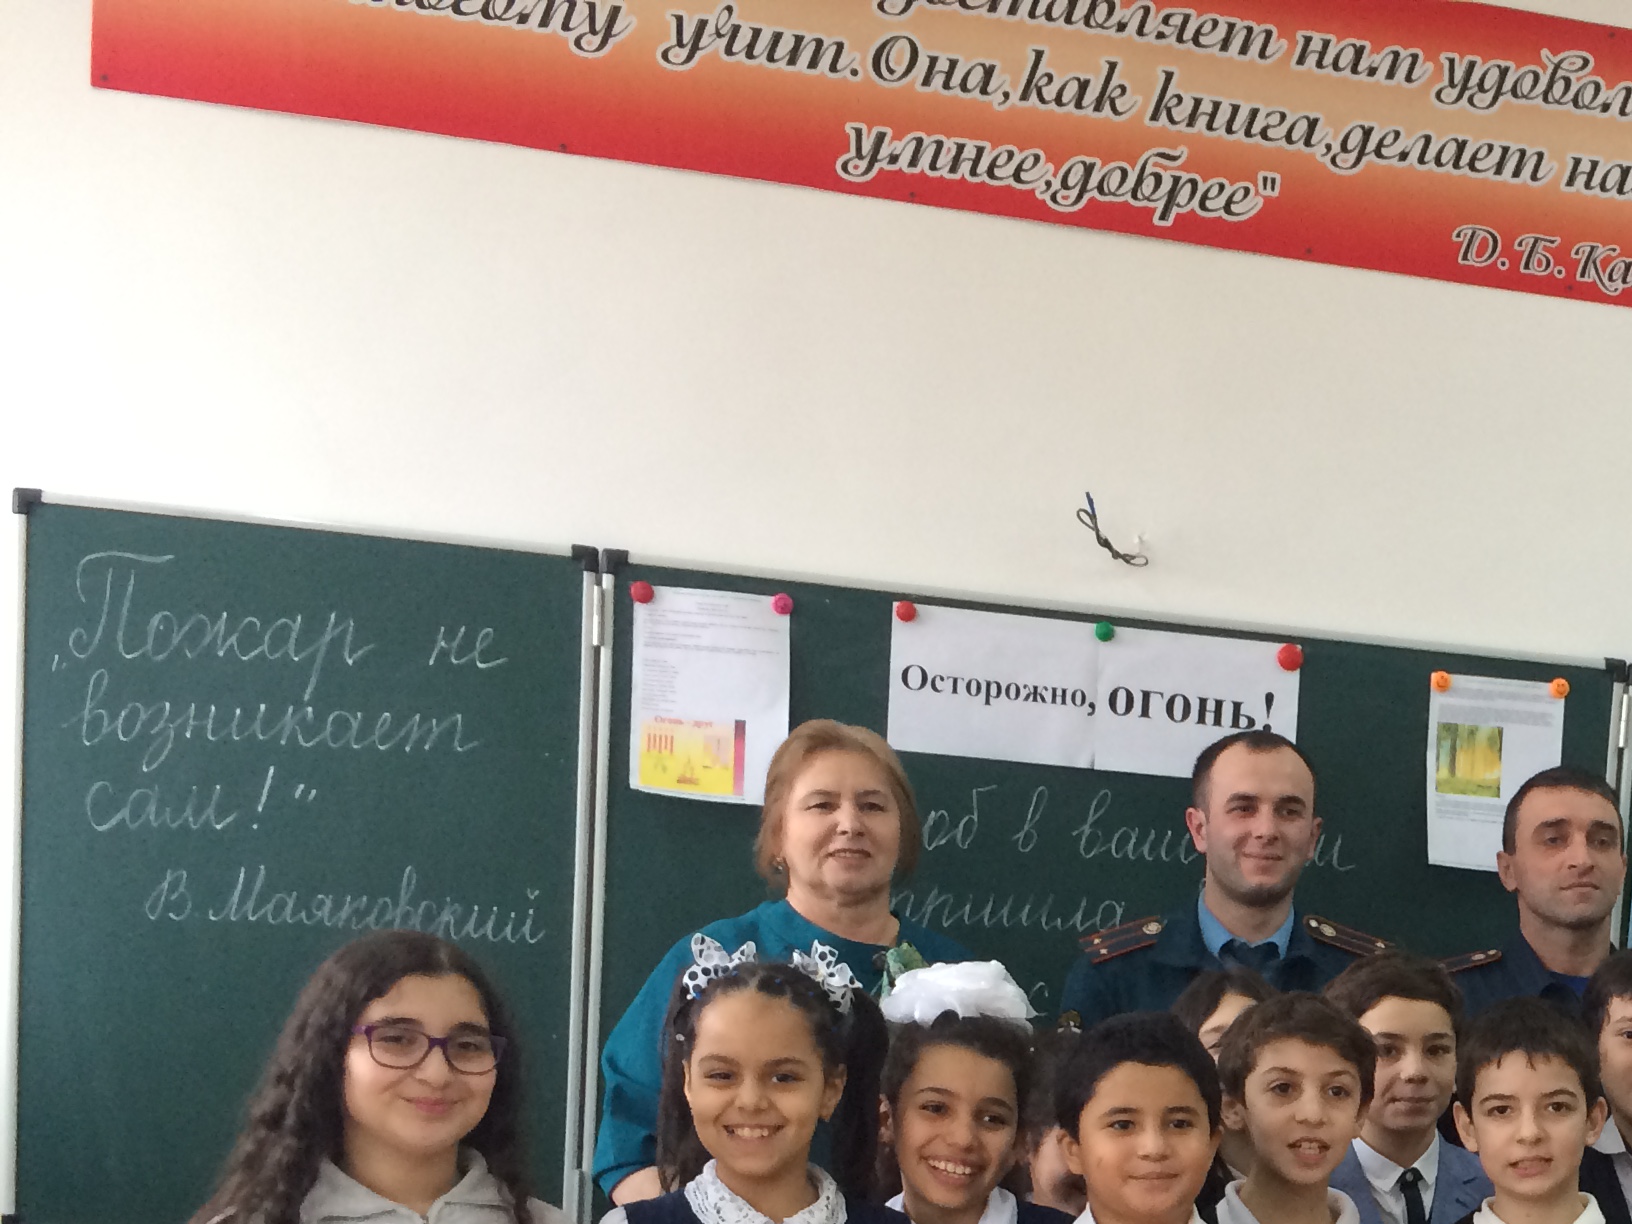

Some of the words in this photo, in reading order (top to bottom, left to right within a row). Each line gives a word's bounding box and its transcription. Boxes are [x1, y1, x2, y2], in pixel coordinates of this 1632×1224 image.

[1295, 33, 1428, 84] нам
[429, 625, 508, 668] не
[62, 669, 478, 772] возникает
[901, 664, 1096, 717] Осторожно,
[1108, 687, 1275, 732] огонь!
[1012, 786, 1047, 852] в
[209, 865, 546, 943] Маяковский
